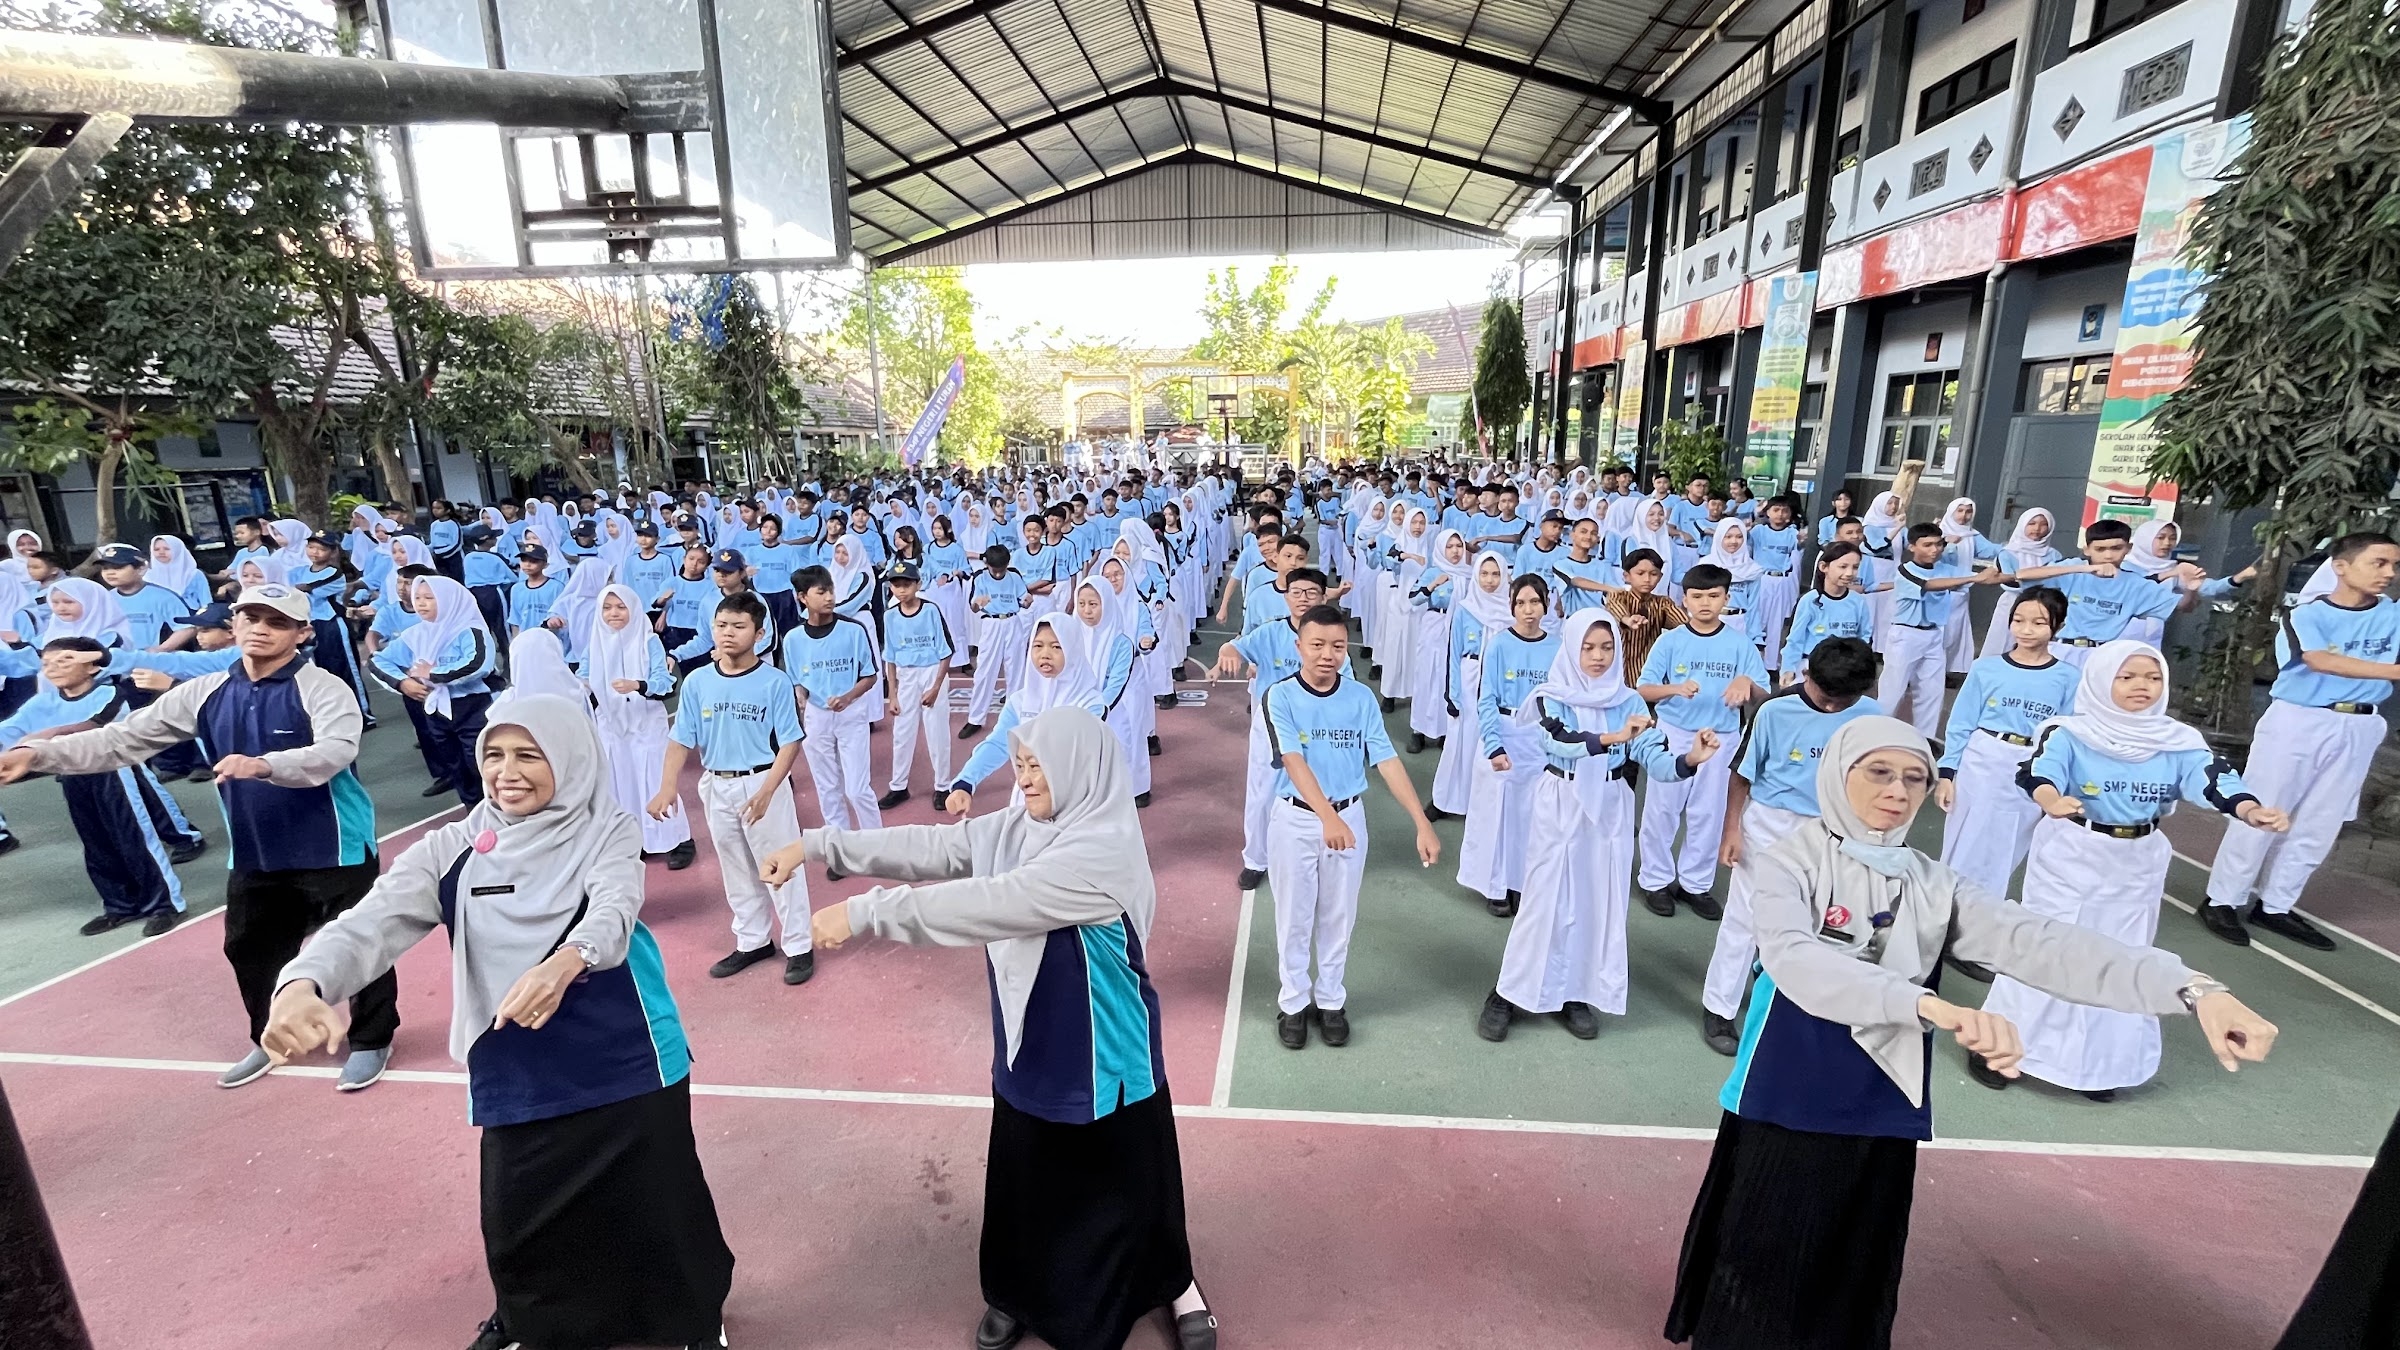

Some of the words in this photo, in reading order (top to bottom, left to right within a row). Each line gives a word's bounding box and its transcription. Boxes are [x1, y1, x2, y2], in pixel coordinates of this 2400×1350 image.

[825, 658, 849, 668] NEGERI
[1284, 659, 1297, 669] SMP
[1705, 662, 1734, 673] NEGERI
[1705, 671, 1731, 679] TUREN
[2001, 697, 2022, 708] SMP
[713, 702, 730, 713] SMP
[731, 703, 760, 715] NEGERI
[760, 706, 767, 722] 1
[731, 713, 757, 722] TUREN
[1311, 729, 1327, 740] SMP
[1328, 729, 1355, 740] NEGERI
[1356, 729, 1362, 749] 1
[1810, 747, 1824, 759] SM
[2103, 780, 2127, 793] SMP
